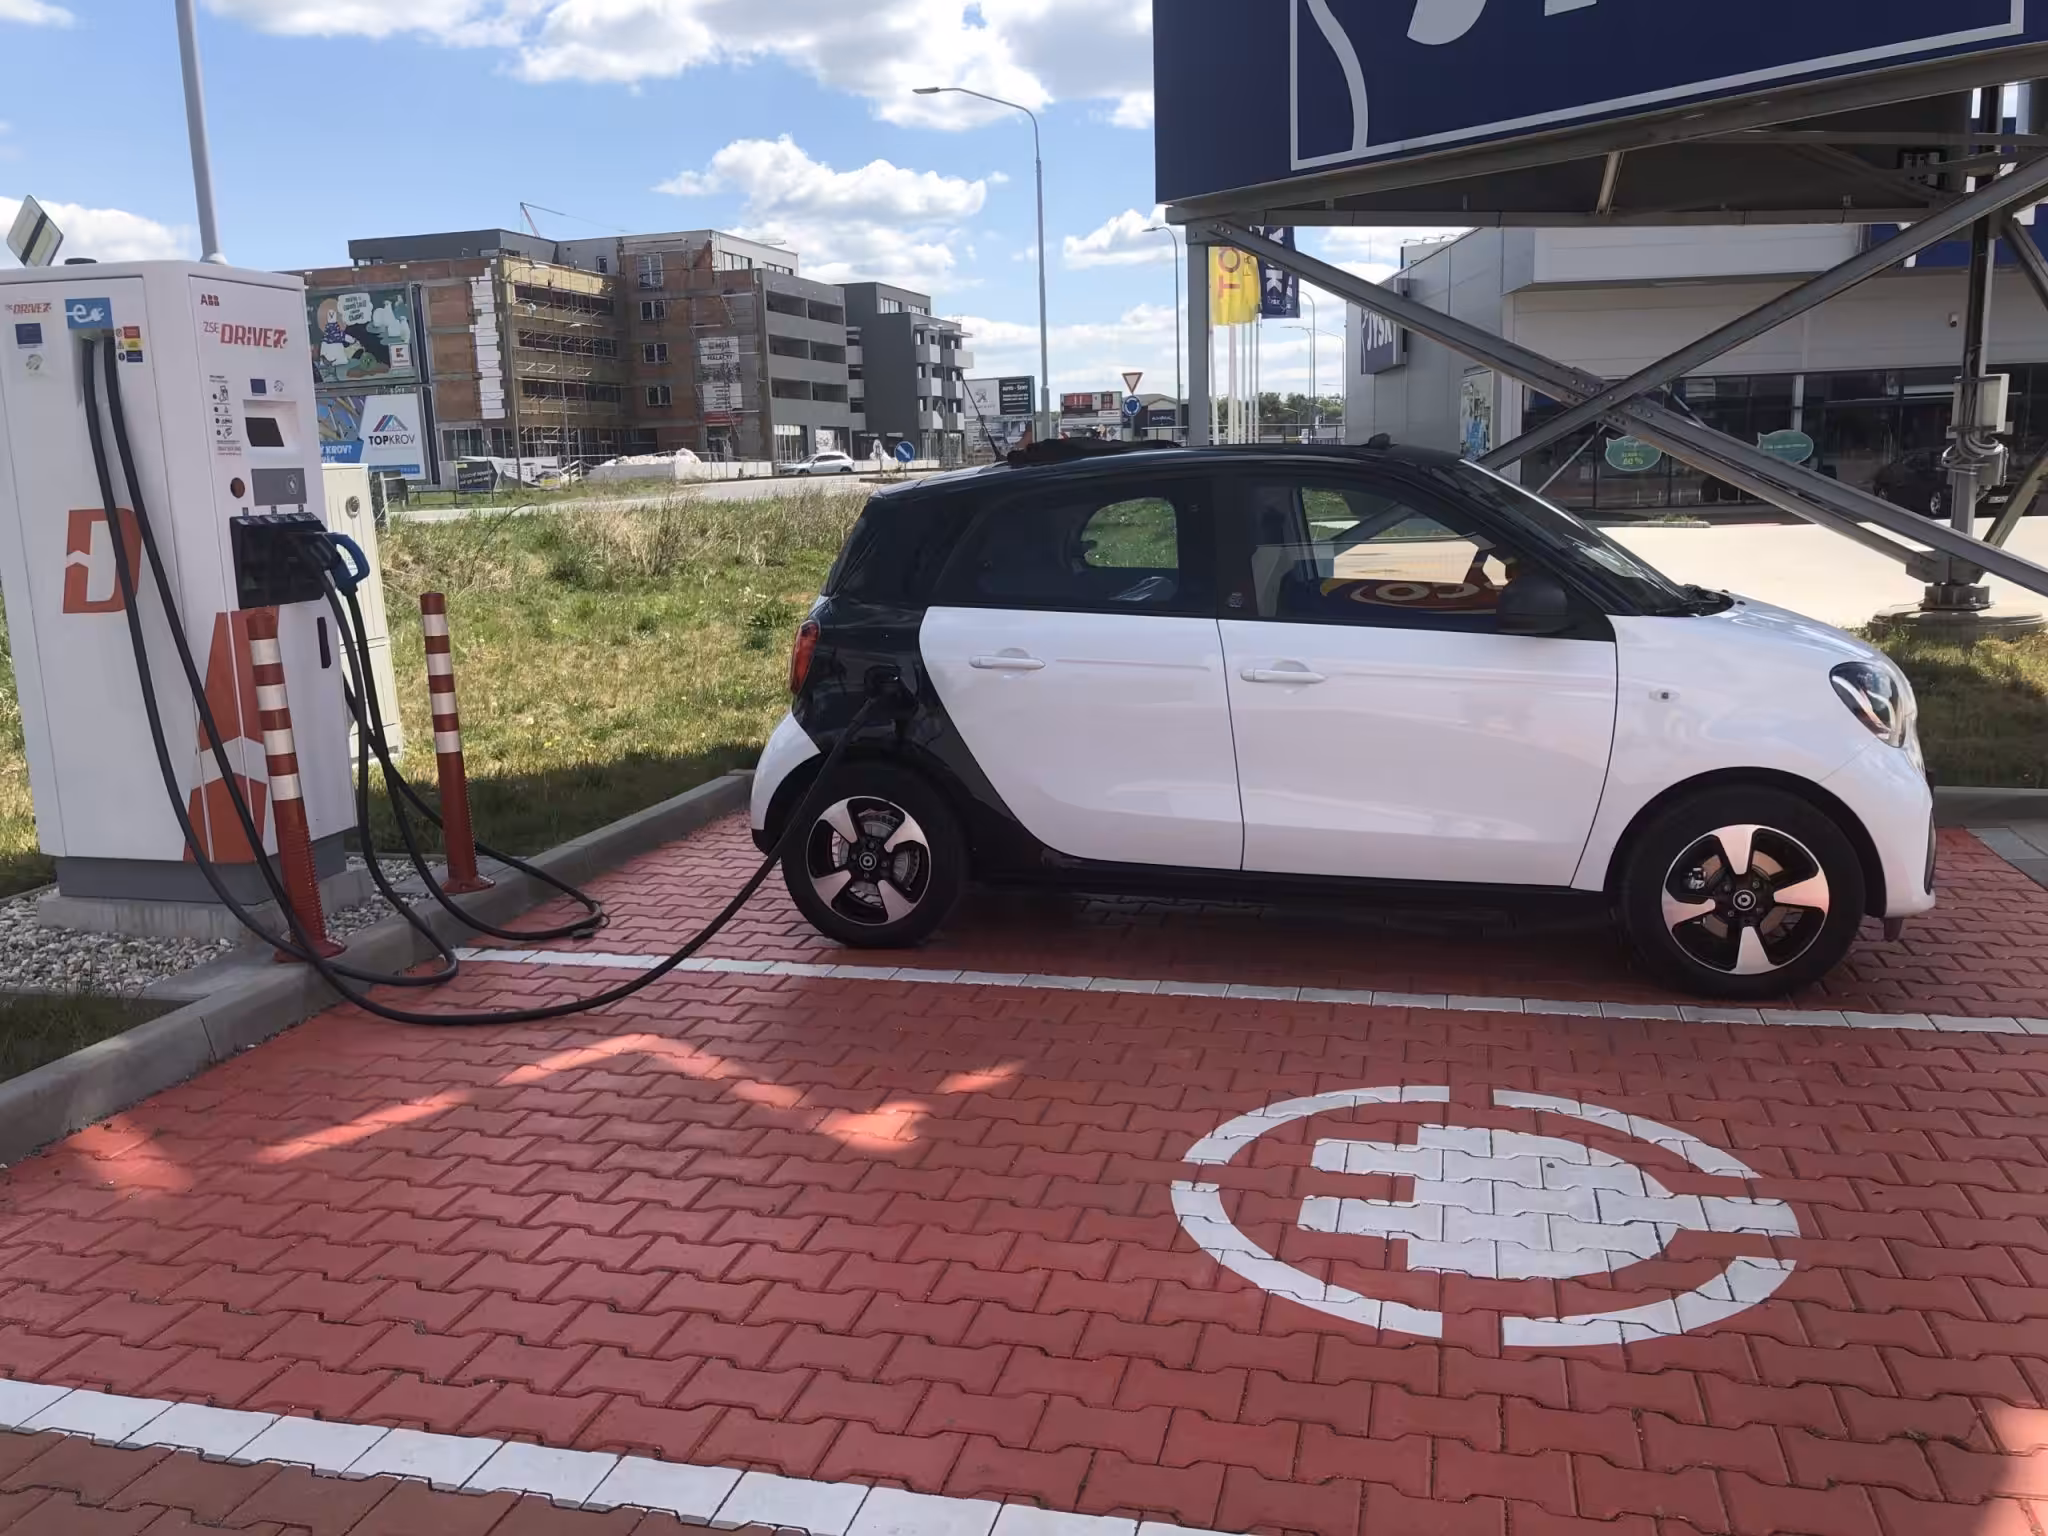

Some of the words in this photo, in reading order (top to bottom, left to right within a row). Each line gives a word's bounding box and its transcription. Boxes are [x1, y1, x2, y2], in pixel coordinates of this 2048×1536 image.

[200, 293, 220, 307] ABB
[203, 321, 219, 334] ZSE
[368, 434, 416, 446] TOPKROV
[325, 444, 353, 454] KROV?
